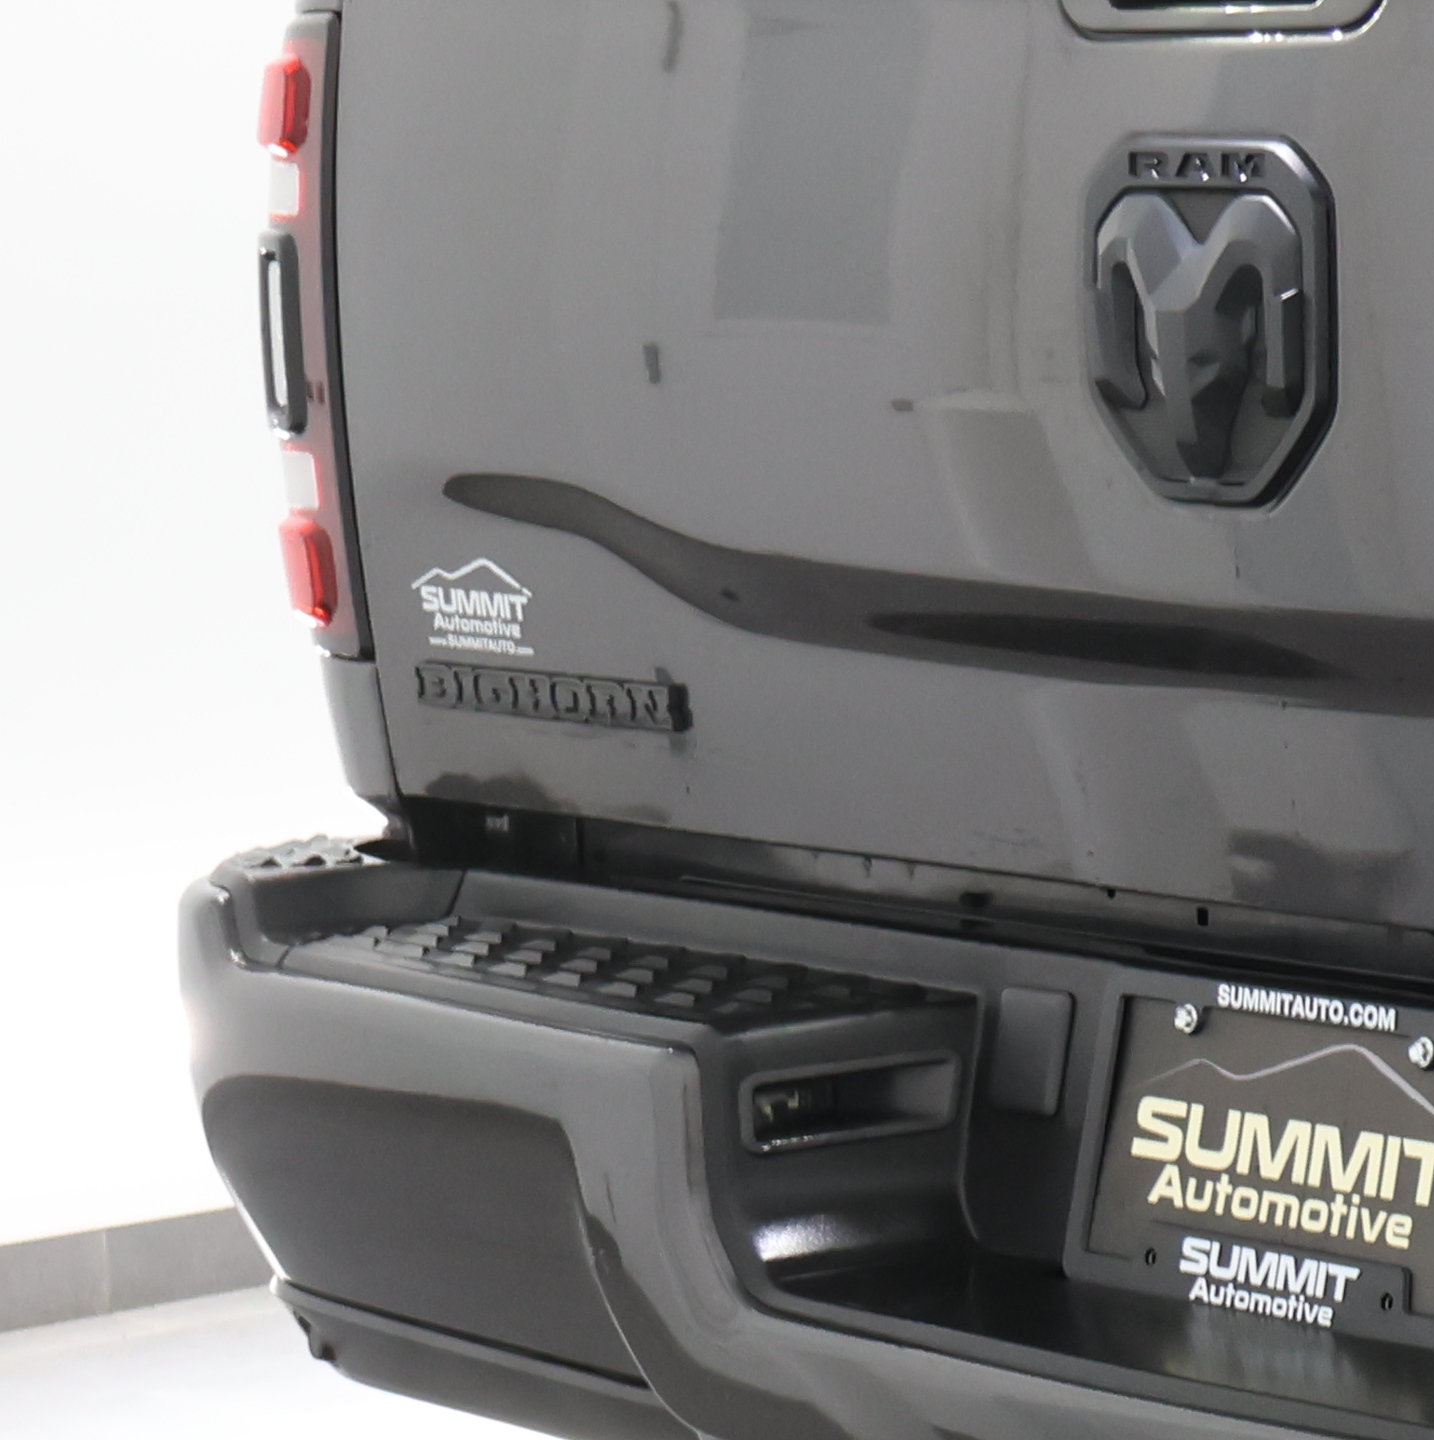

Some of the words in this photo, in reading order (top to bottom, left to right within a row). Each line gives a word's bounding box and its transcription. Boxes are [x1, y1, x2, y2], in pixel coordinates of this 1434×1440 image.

[1128, 151, 1266, 182] RAM
[420, 585, 529, 622] SUMMIT
[433, 613, 521, 640] Automotive
[1216, 983, 1397, 1032] SUMMITAUTO.COM
[1146, 1163, 1414, 1250] Automotive
[1178, 1235, 1361, 1303] SUMMIT
[1188, 1276, 1334, 1328] Automotive
